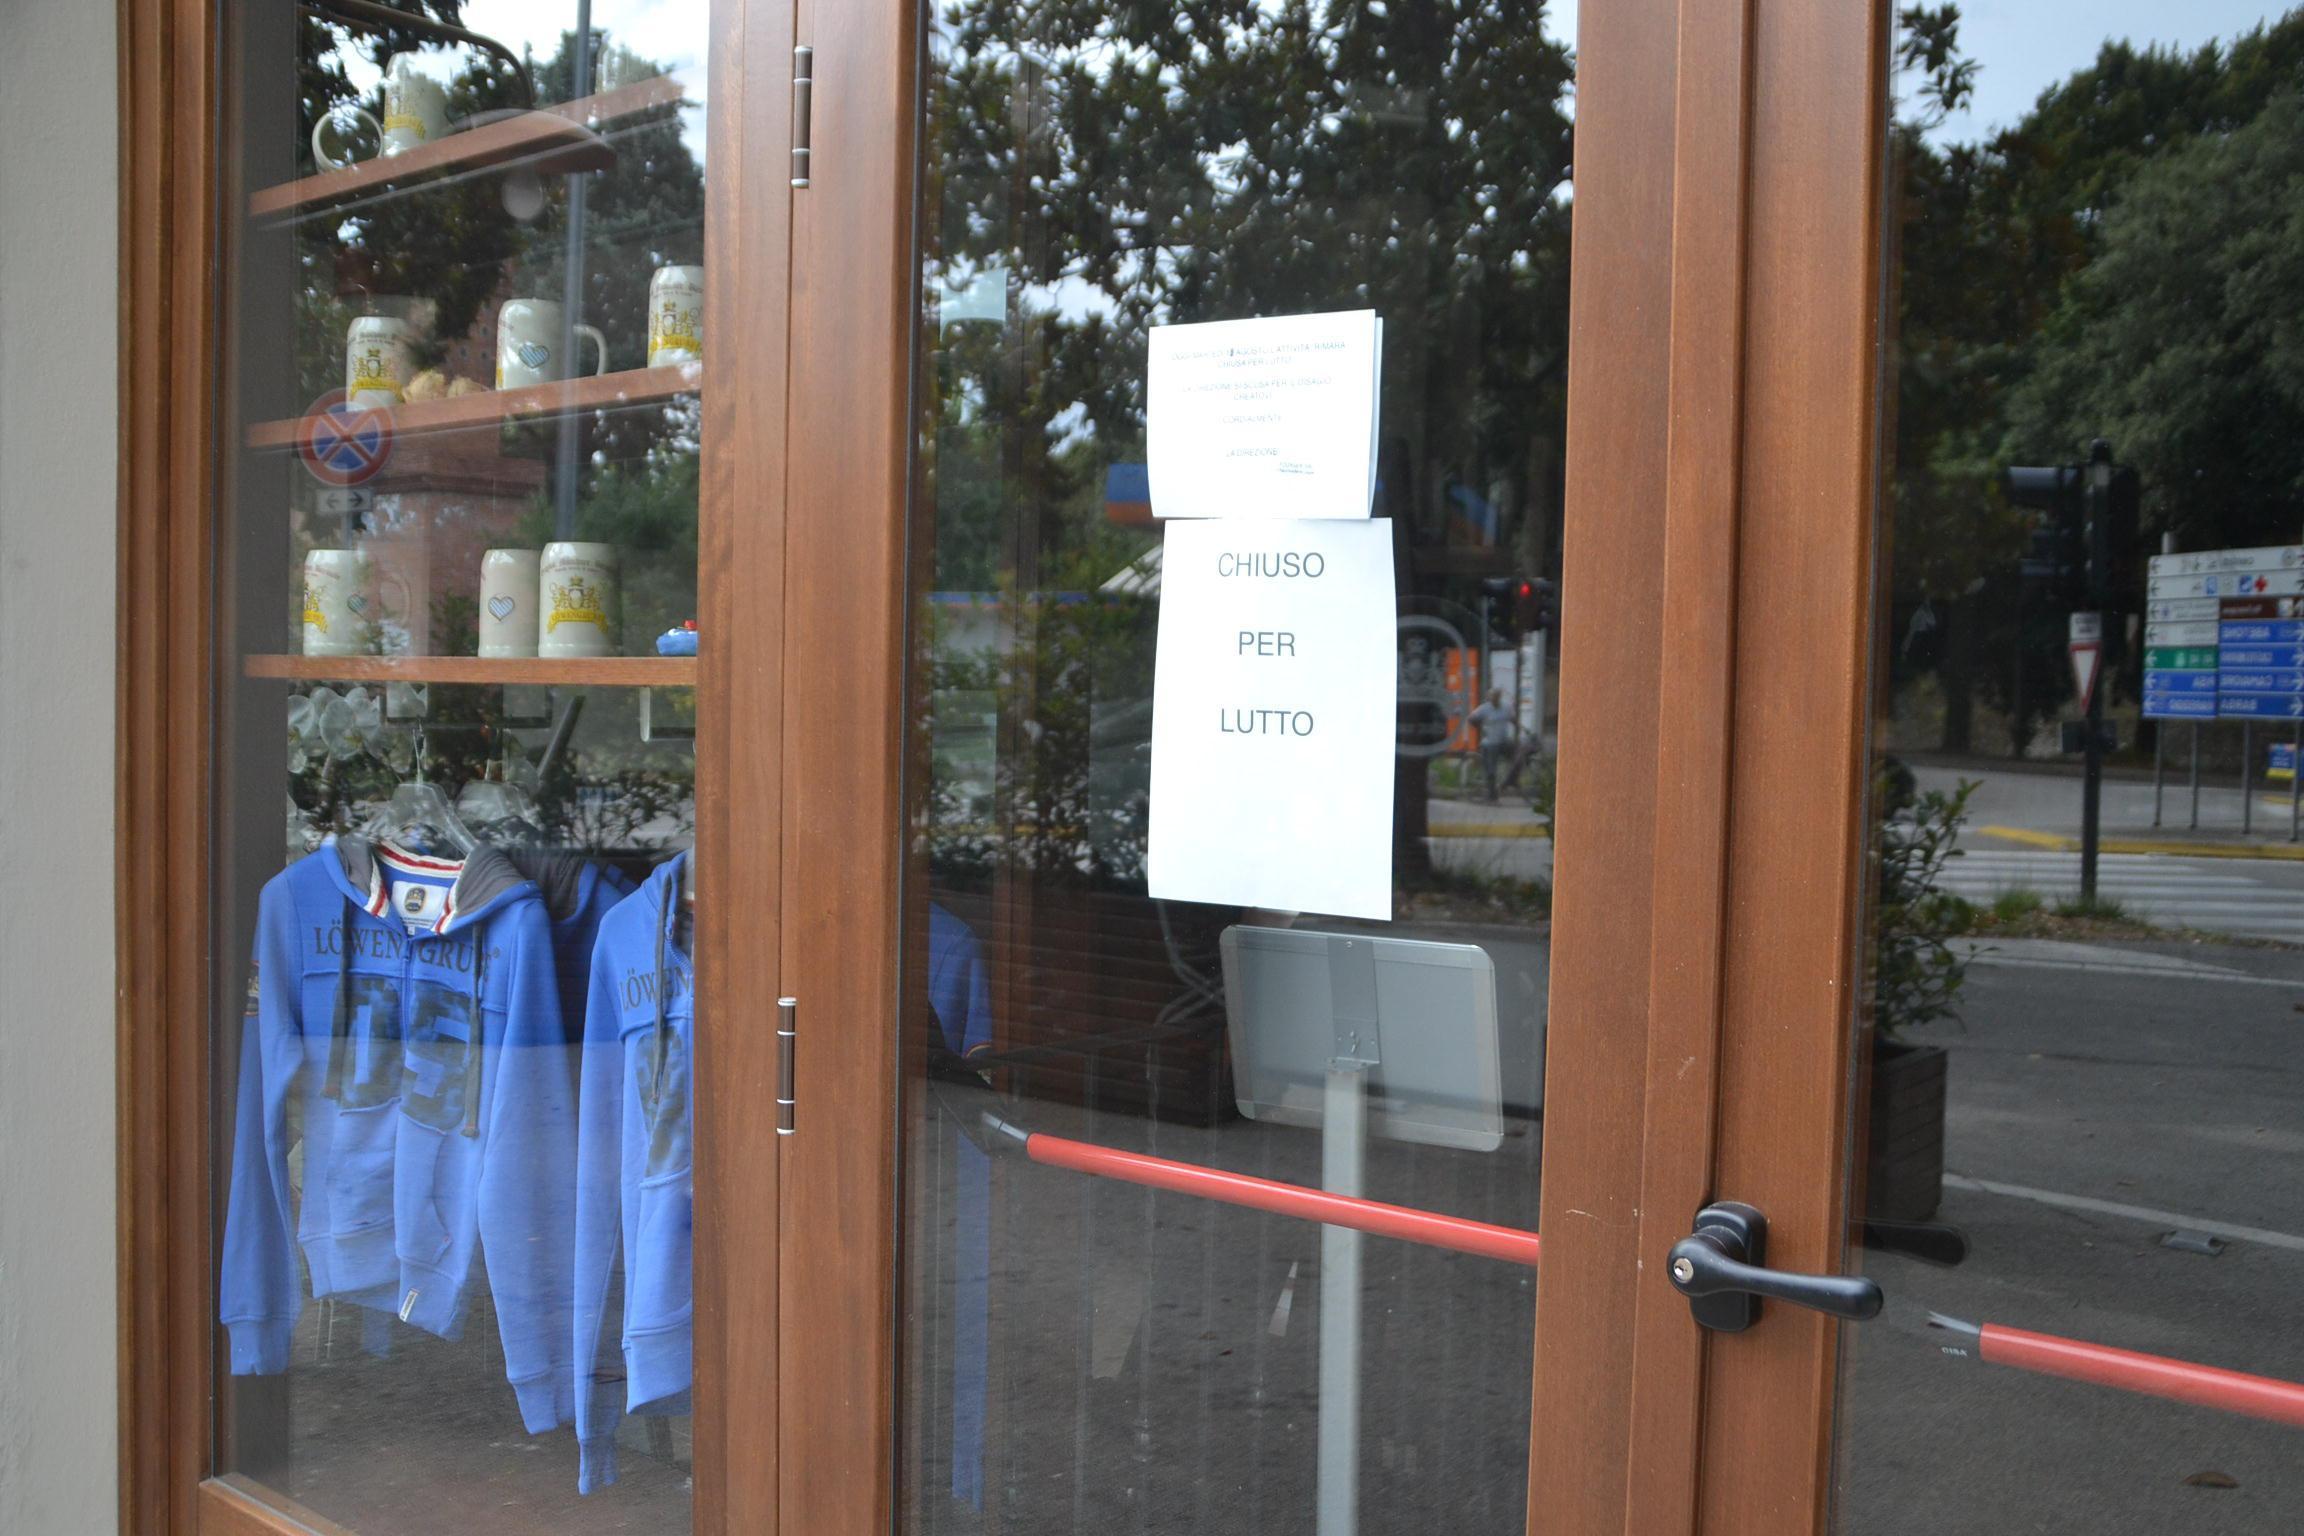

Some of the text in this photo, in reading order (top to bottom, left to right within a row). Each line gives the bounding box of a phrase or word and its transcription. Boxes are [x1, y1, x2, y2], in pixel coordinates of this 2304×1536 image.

[1217, 552, 1325, 578] CHIUSO
[1238, 631, 1296, 657] PER
[1221, 708, 1314, 736] LUTTO
